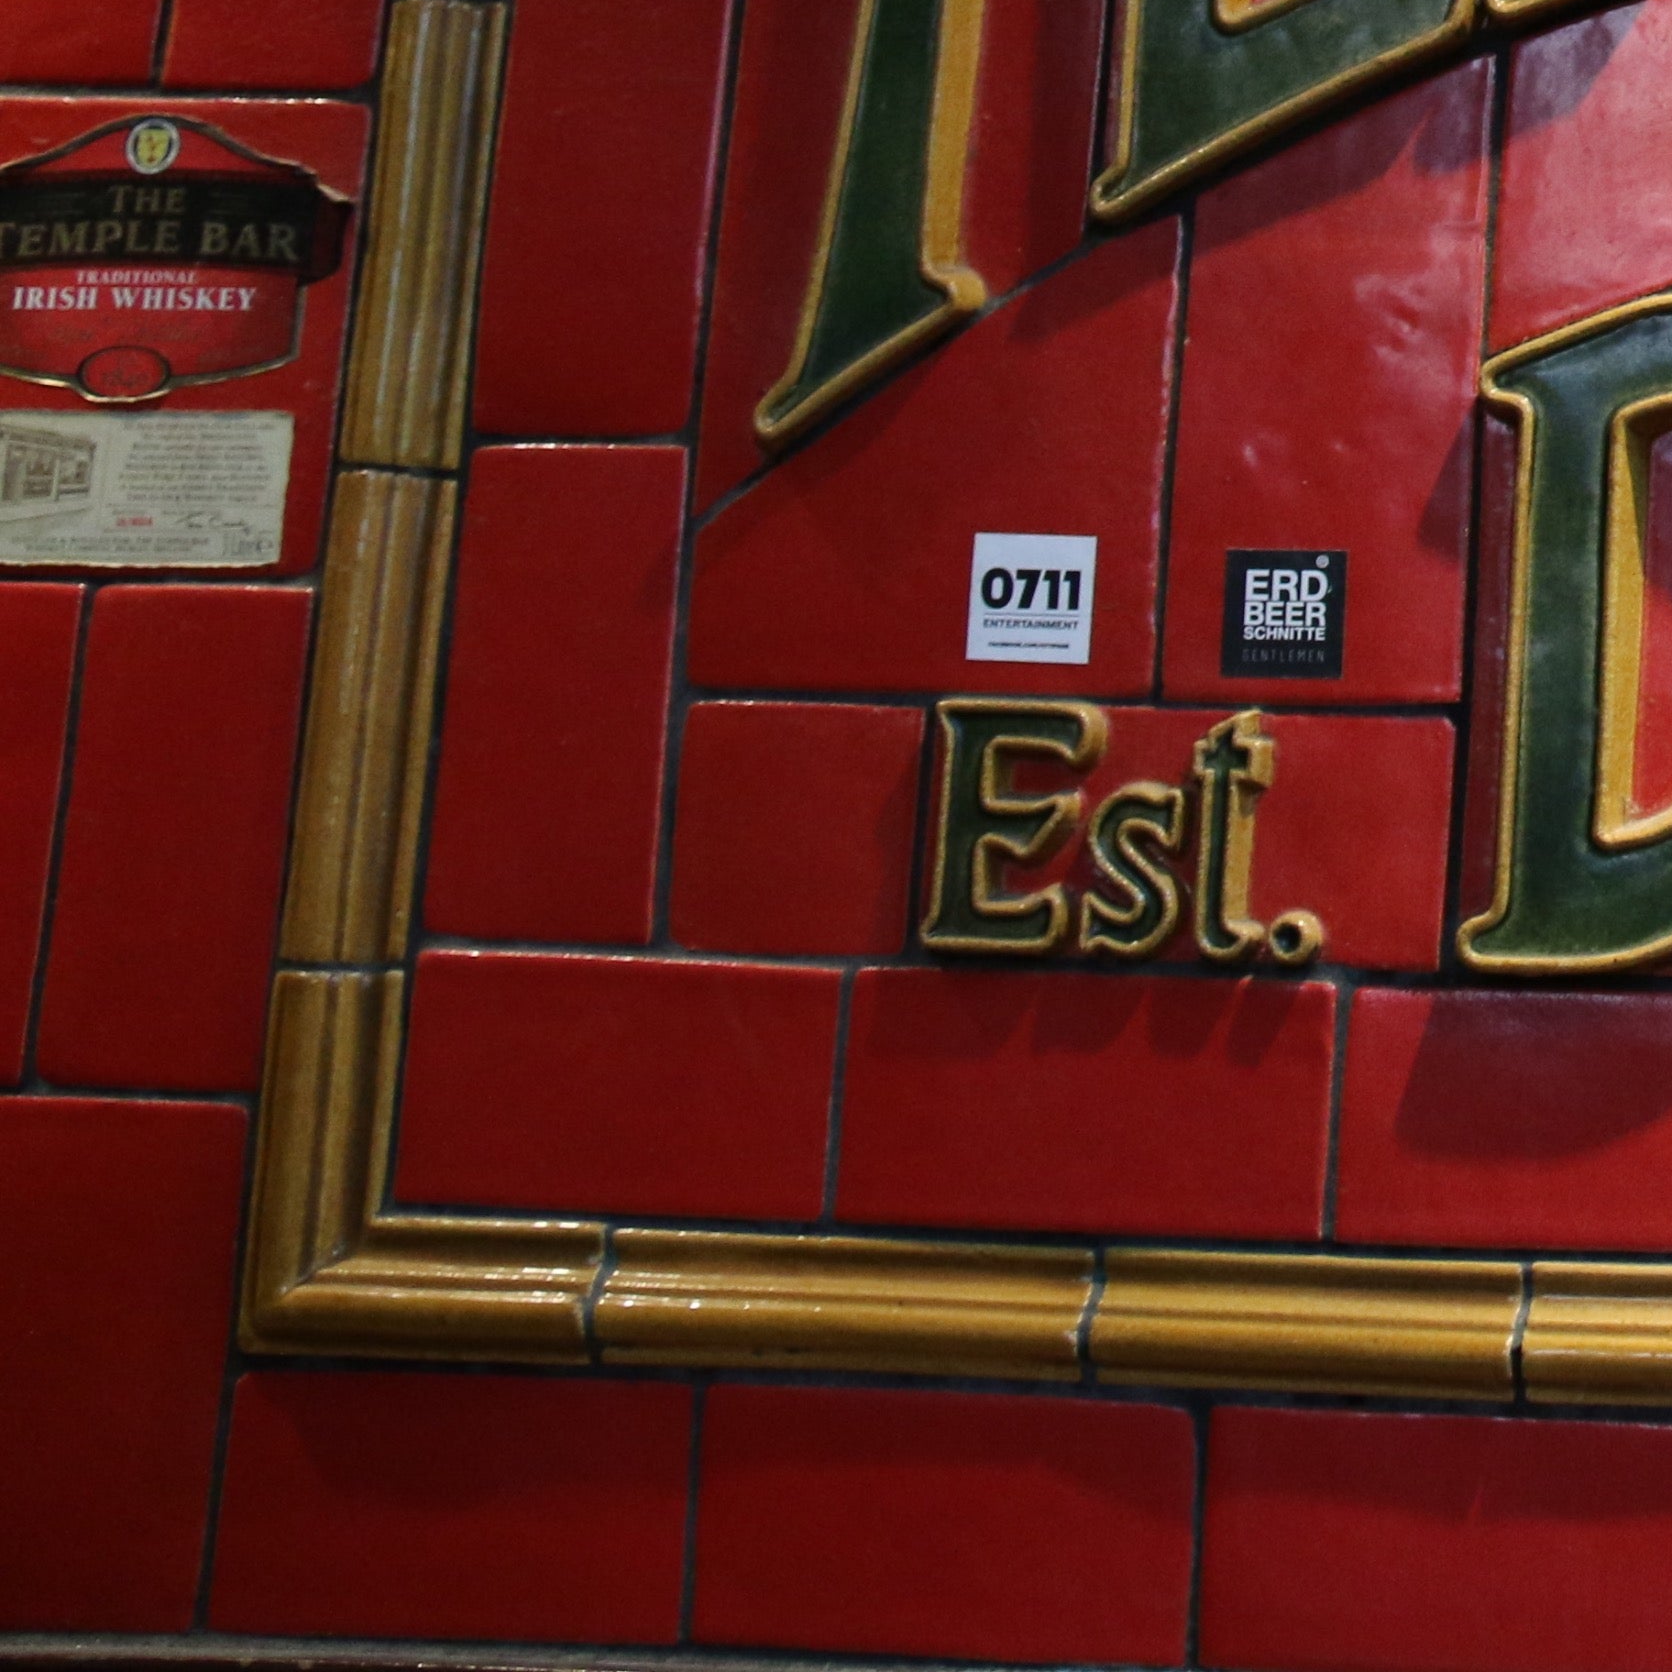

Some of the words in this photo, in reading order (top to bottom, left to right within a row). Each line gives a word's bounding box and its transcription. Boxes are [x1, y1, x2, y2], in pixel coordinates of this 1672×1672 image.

[109, 185, 187, 214] THE
[199, 222, 300, 261] BAR
[76, 270, 198, 284] TRADITIONAL
[12, 286, 98, 310] IRISH
[111, 286, 257, 311] WHISKEY
[981, 567, 1081, 611] 0711
[1244, 568, 1329, 602] ERD
[982, 618, 1079, 630] ENTERTAINMENT
[1243, 601, 1327, 627] BEER
[1243, 626, 1326, 641] SCHNITTE
[920, 696, 1324, 965] Est.
